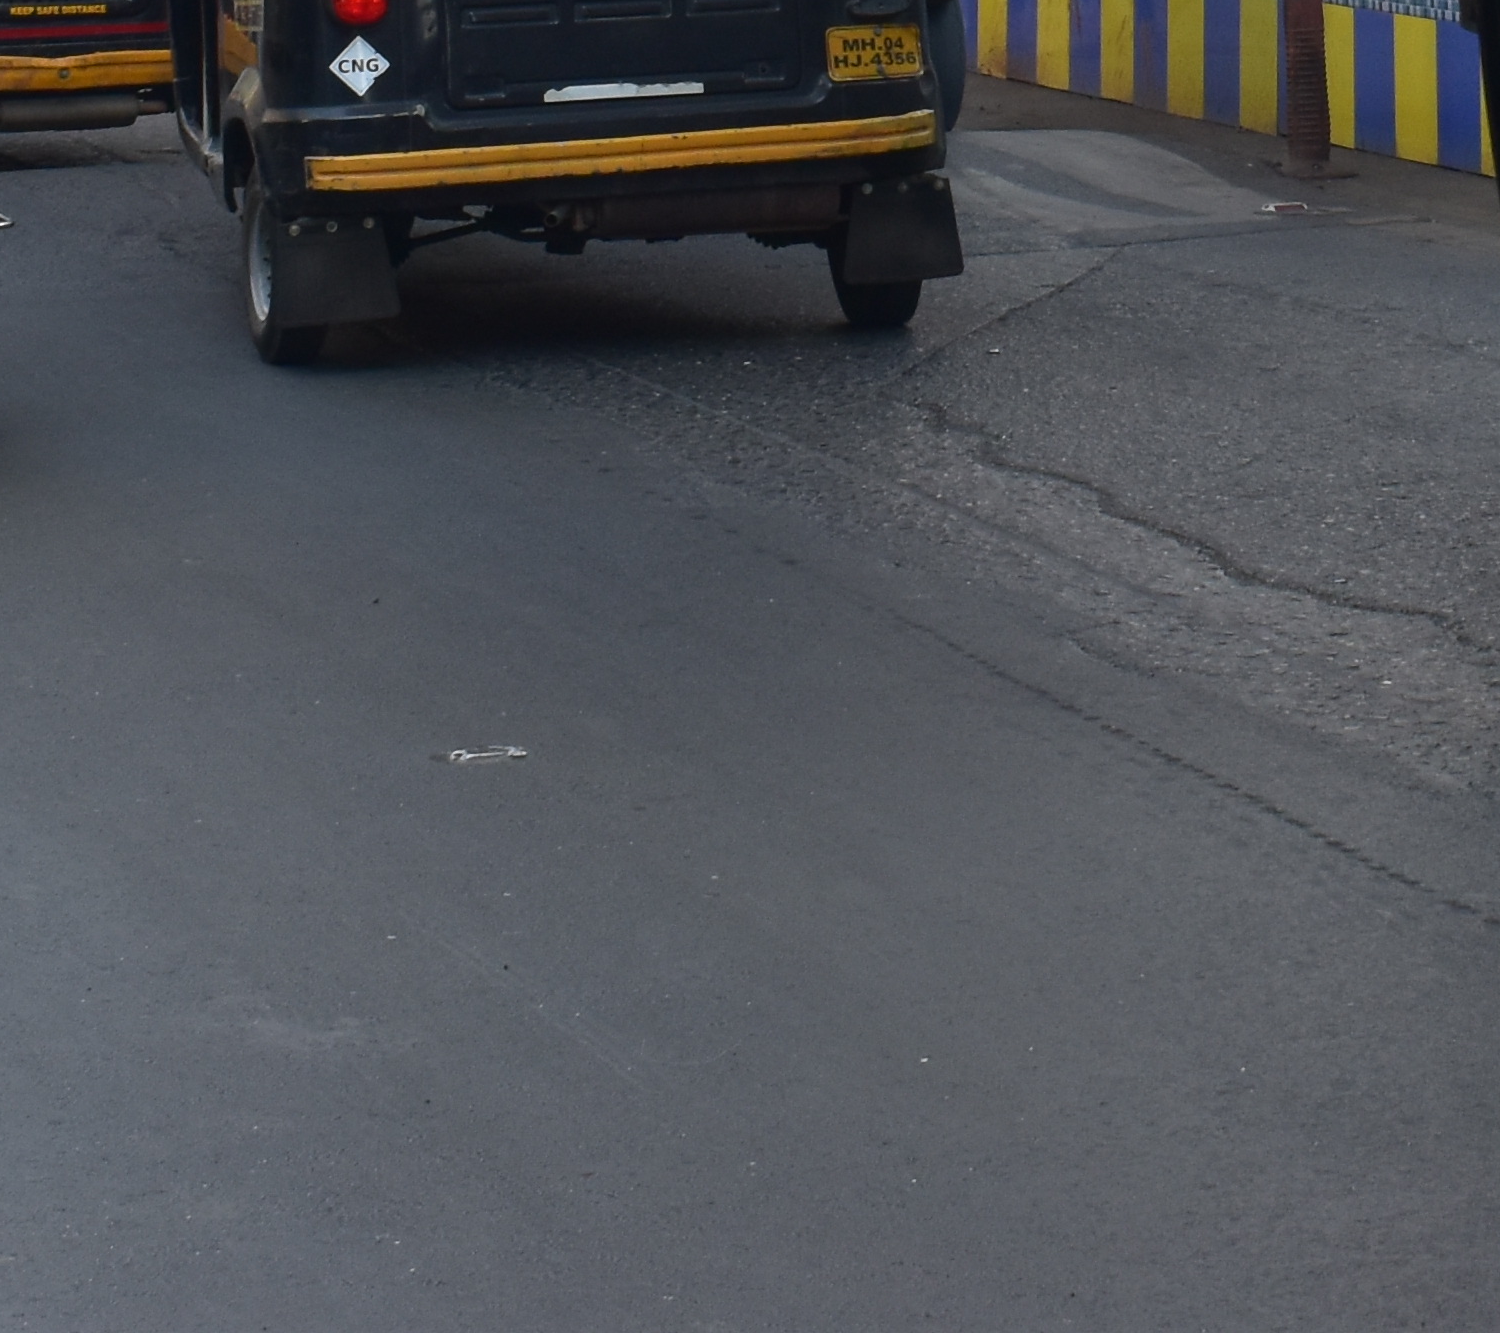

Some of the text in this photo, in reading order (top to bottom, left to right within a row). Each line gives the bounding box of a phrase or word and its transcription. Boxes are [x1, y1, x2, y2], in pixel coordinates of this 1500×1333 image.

[10, 5, 107, 16] KEEP SAFE DISTANCE
[842, 37, 904, 53] MH.04
[338, 58, 379, 74] CNG
